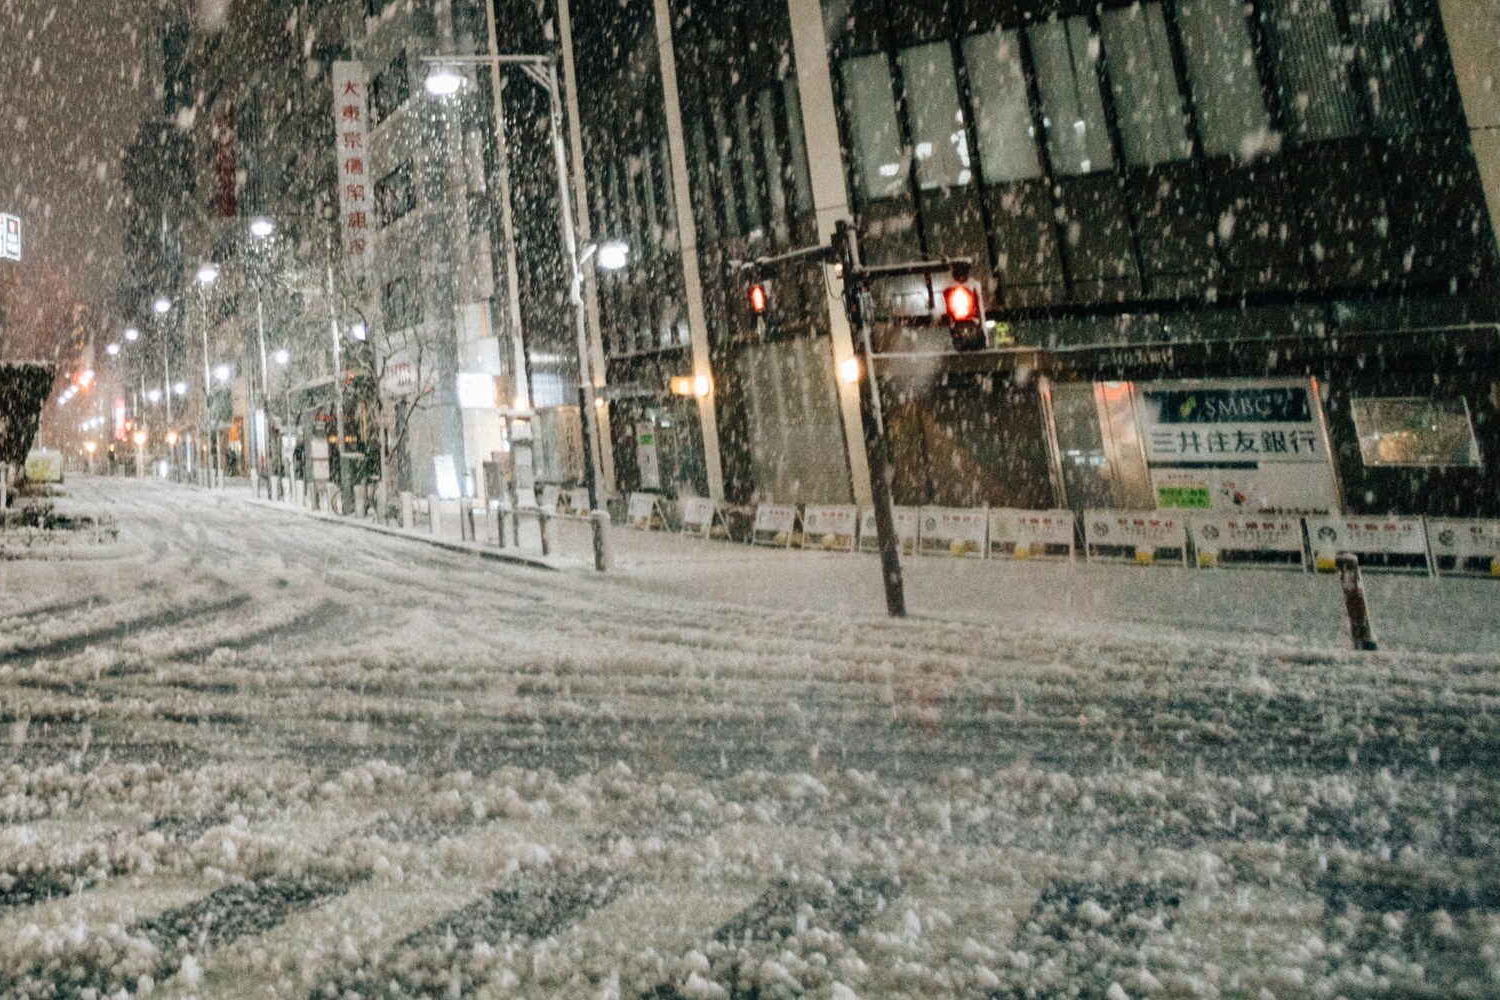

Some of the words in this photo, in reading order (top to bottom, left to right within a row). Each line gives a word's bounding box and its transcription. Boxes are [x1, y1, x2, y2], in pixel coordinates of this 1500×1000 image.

[1204, 396, 1271, 416] SMBC
[1151, 430, 1317, 454] 三井住友銀行
